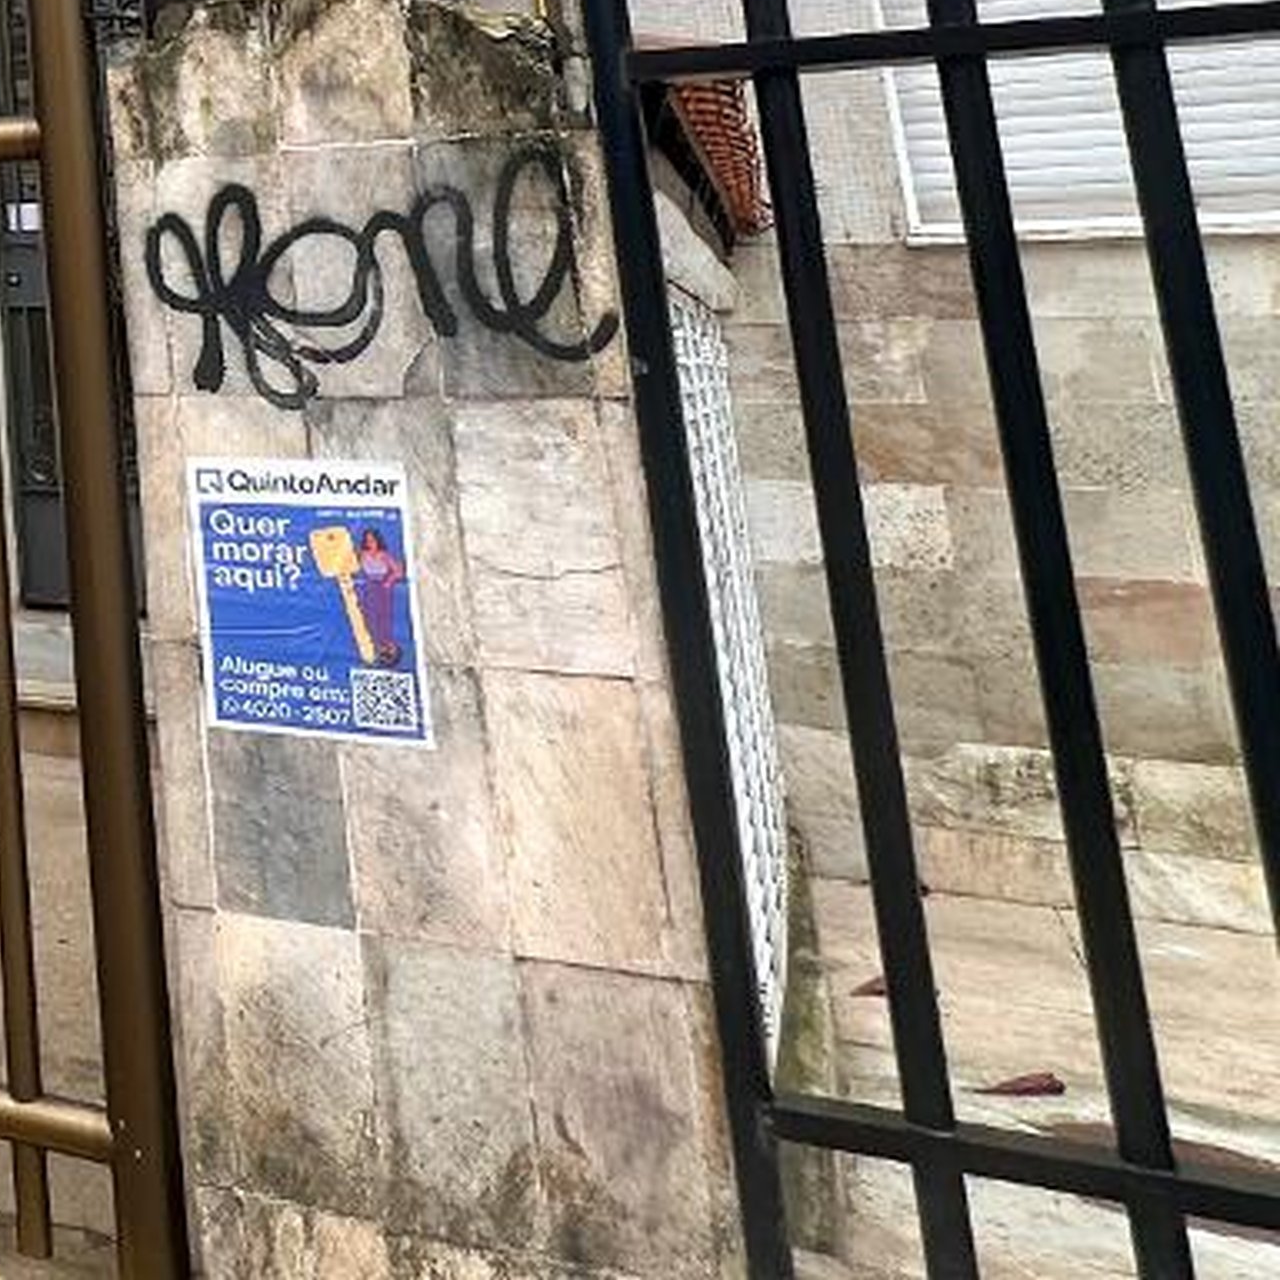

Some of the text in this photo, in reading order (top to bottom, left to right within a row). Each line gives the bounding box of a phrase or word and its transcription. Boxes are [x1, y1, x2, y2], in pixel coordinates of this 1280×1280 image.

[227, 469, 400, 496] QuintoAndar
[209, 509, 291, 537] Quer
[212, 540, 308, 565] morar
[212, 564, 302, 593] aqui?
[219, 655, 330, 682] Alugue ou
[219, 679, 351, 703] compre em:
